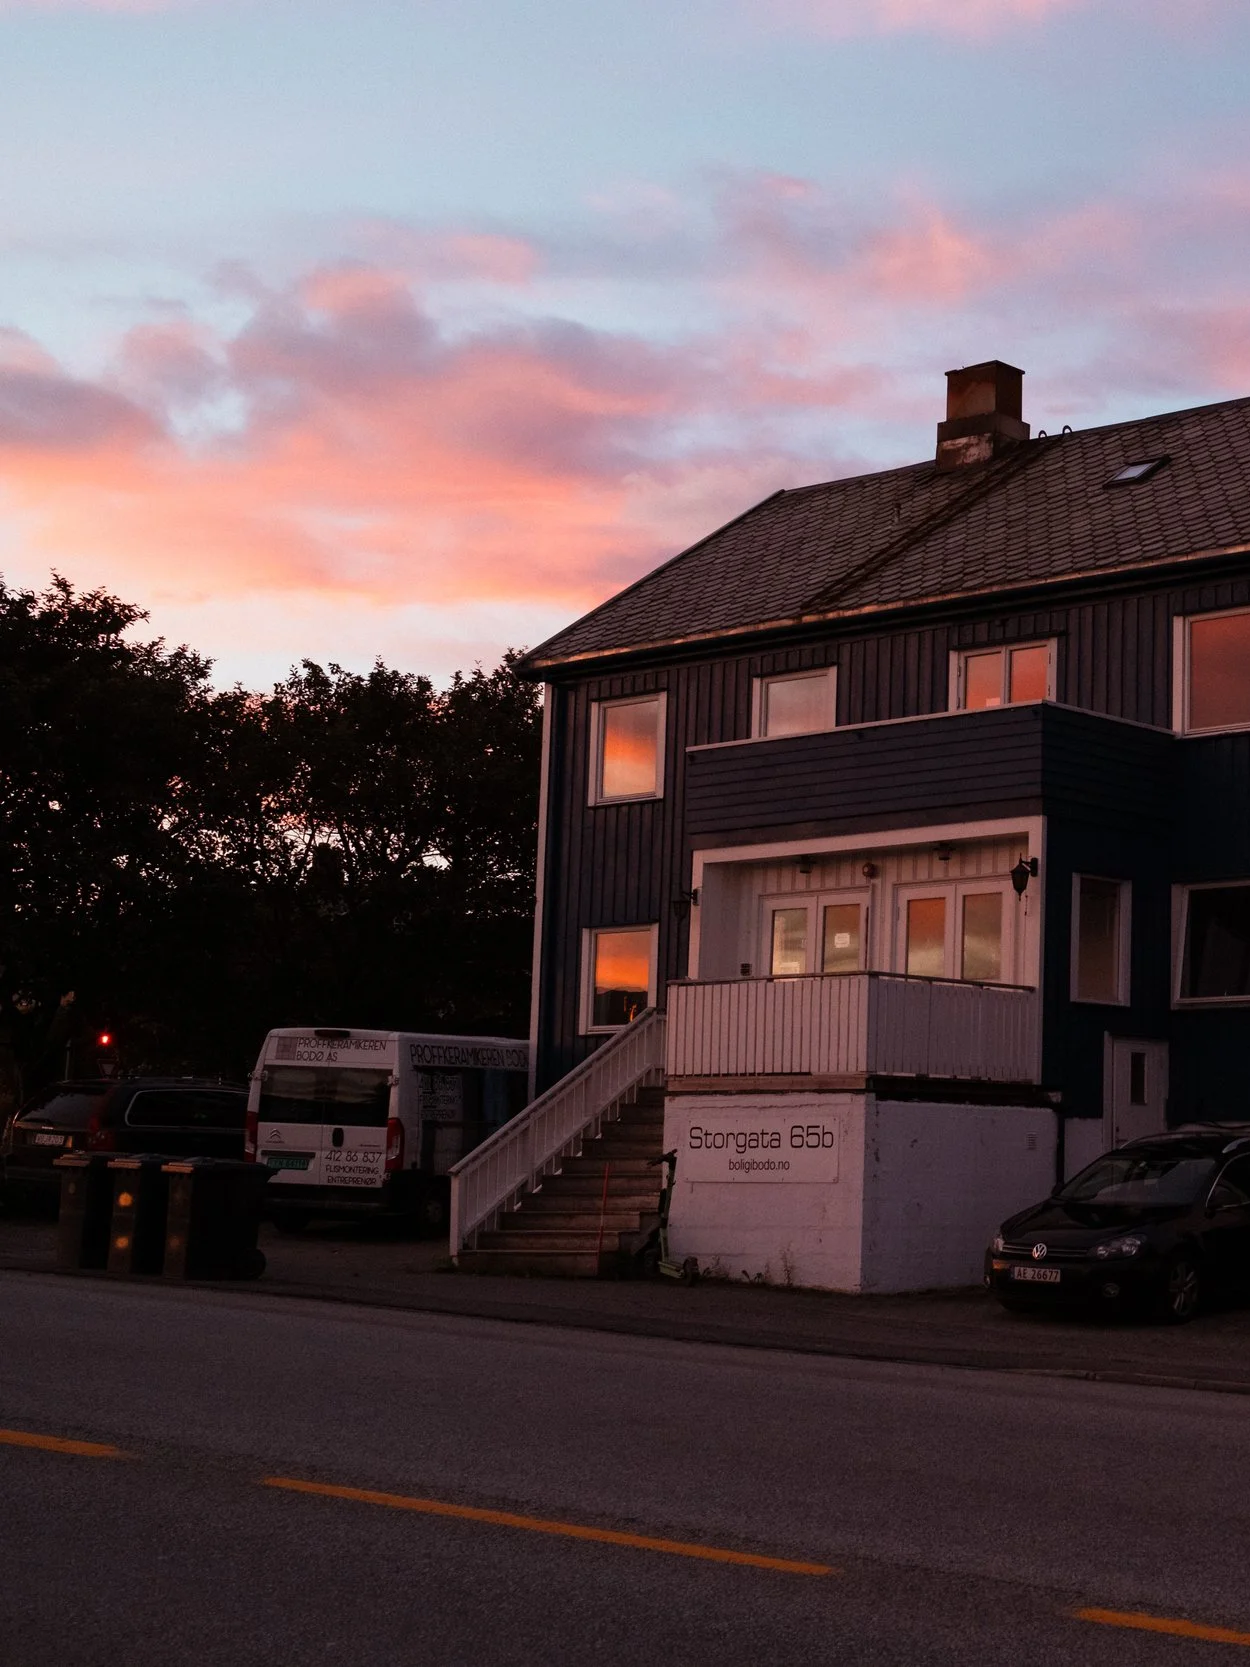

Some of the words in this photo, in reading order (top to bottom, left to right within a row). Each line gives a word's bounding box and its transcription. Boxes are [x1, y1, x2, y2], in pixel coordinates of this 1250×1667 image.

[326, 1051, 338, 1062] AS
[689, 1126, 781, 1154] Storgata
[790, 1125, 834, 1149] 65b
[325, 1150, 342, 1161] 412
[345, 1150, 358, 1162] 86
[362, 1151, 382, 1163] 837
[728, 1158, 790, 1173] boligibodo.no
[1017, 1268, 1027, 1278] AE
[1031, 1269, 1059, 1281] 26677
